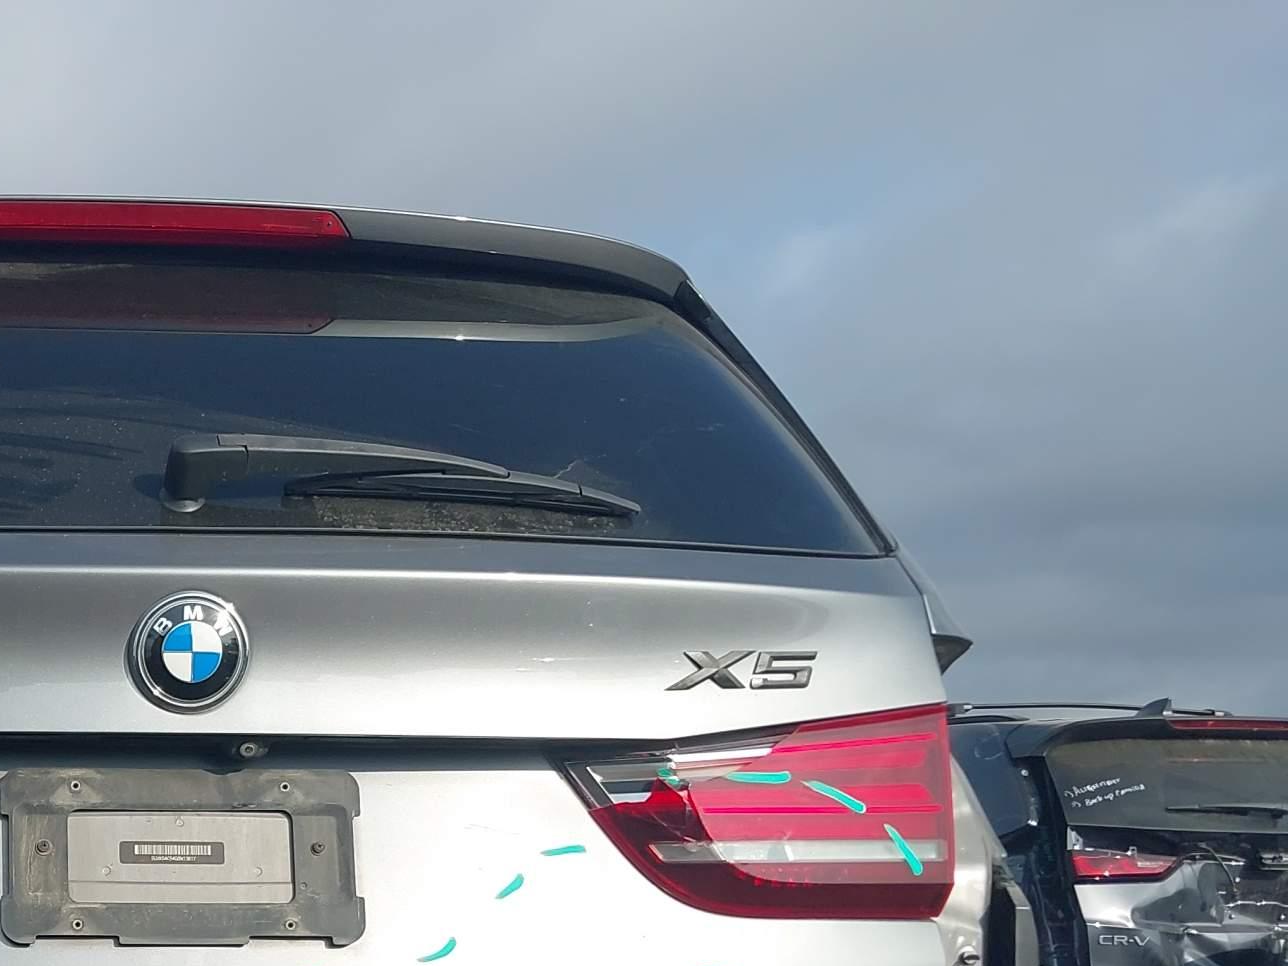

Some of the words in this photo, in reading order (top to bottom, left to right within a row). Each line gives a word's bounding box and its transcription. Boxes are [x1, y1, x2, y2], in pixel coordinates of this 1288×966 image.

[152, 604, 234, 638] BMW
[663, 649, 818, 691] X5
[1098, 934, 1151, 946] CR-V
